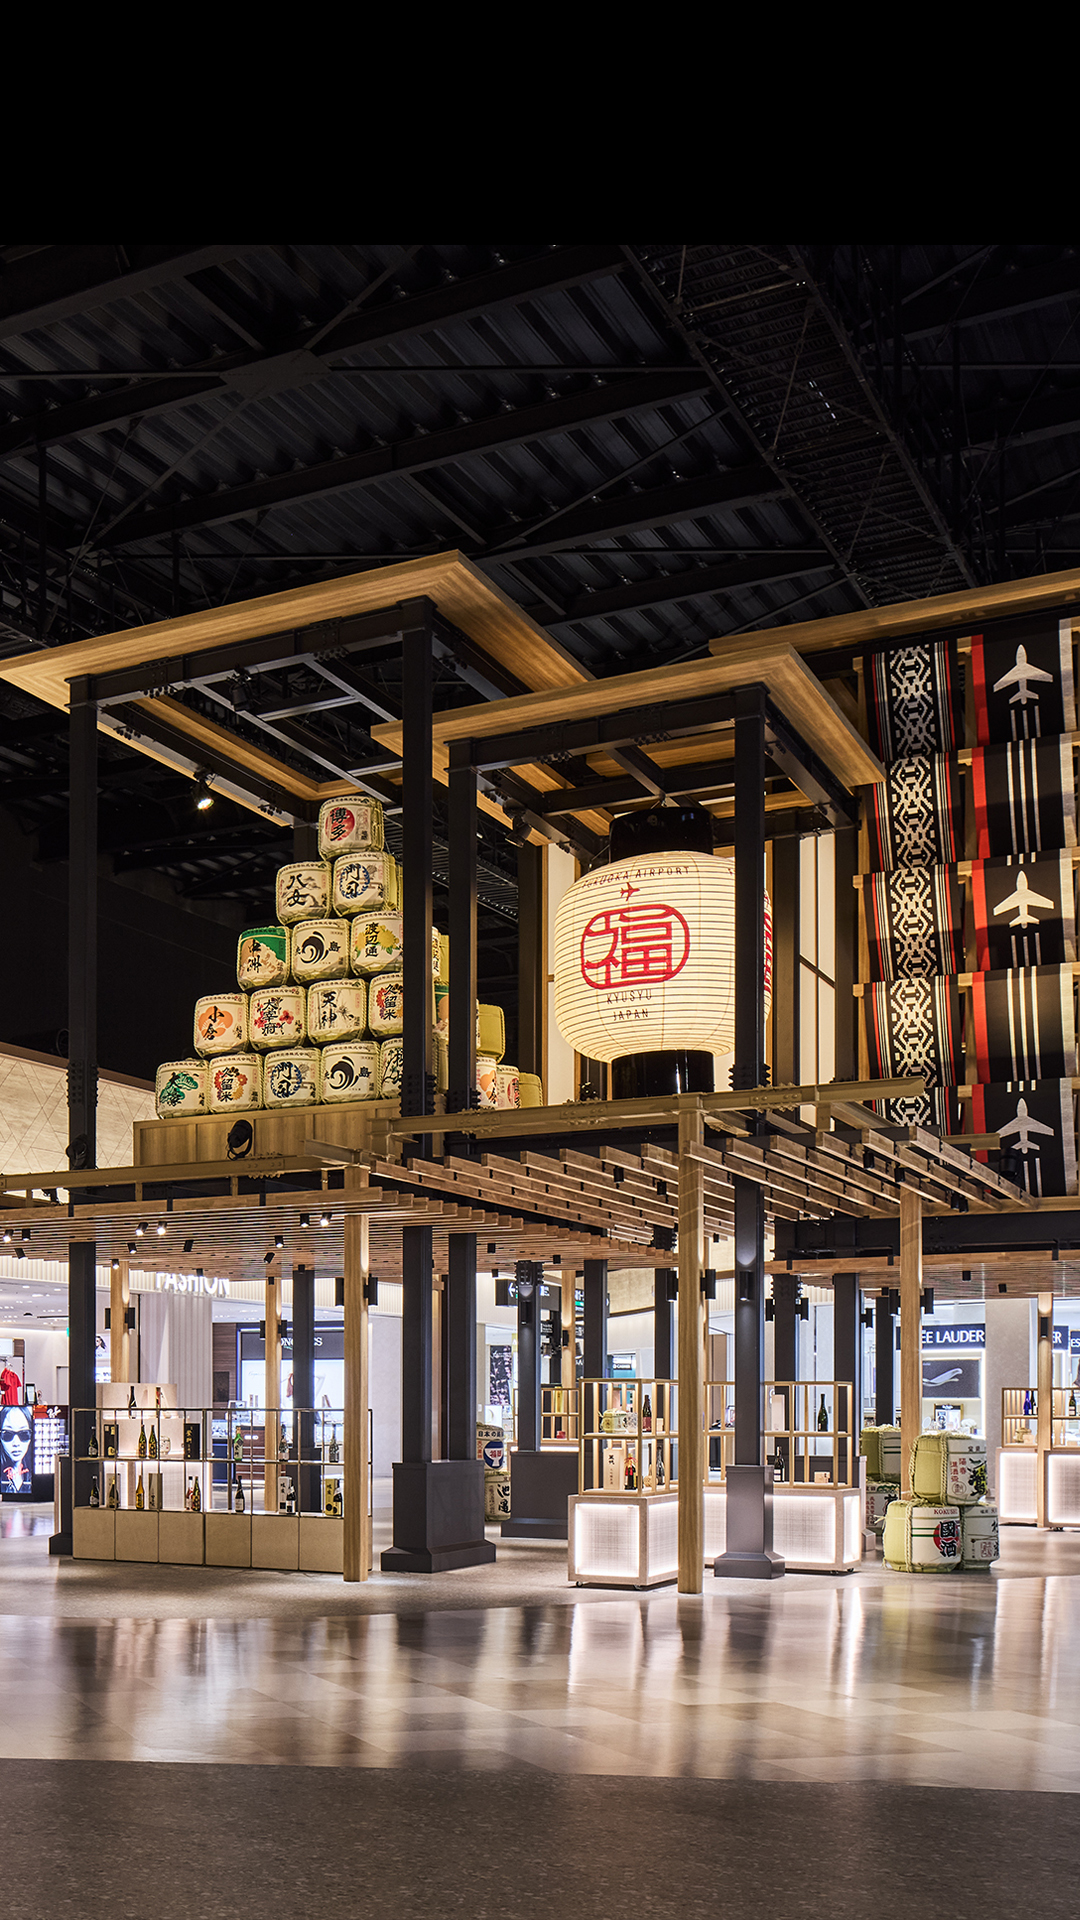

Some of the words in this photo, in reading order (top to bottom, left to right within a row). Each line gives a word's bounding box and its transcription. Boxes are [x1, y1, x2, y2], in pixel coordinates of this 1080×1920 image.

[330, 806, 347, 841] 博多
[285, 873, 310, 908] 八女
[580, 869, 629, 888] FUKUOKA
[635, 866, 690, 879] AIRPORT
[580, 903, 691, 990] 福
[320, 990, 338, 1028] 天神
[383, 984, 399, 1020] 久留米
[606, 988, 653, 1004] KYUSYU
[203, 1005, 225, 1040] 小倉
[613, 1008, 649, 1021] JAPAN
[220, 1066, 235, 1102] 久留米
[936, 1329, 985, 1343] LAUDER
